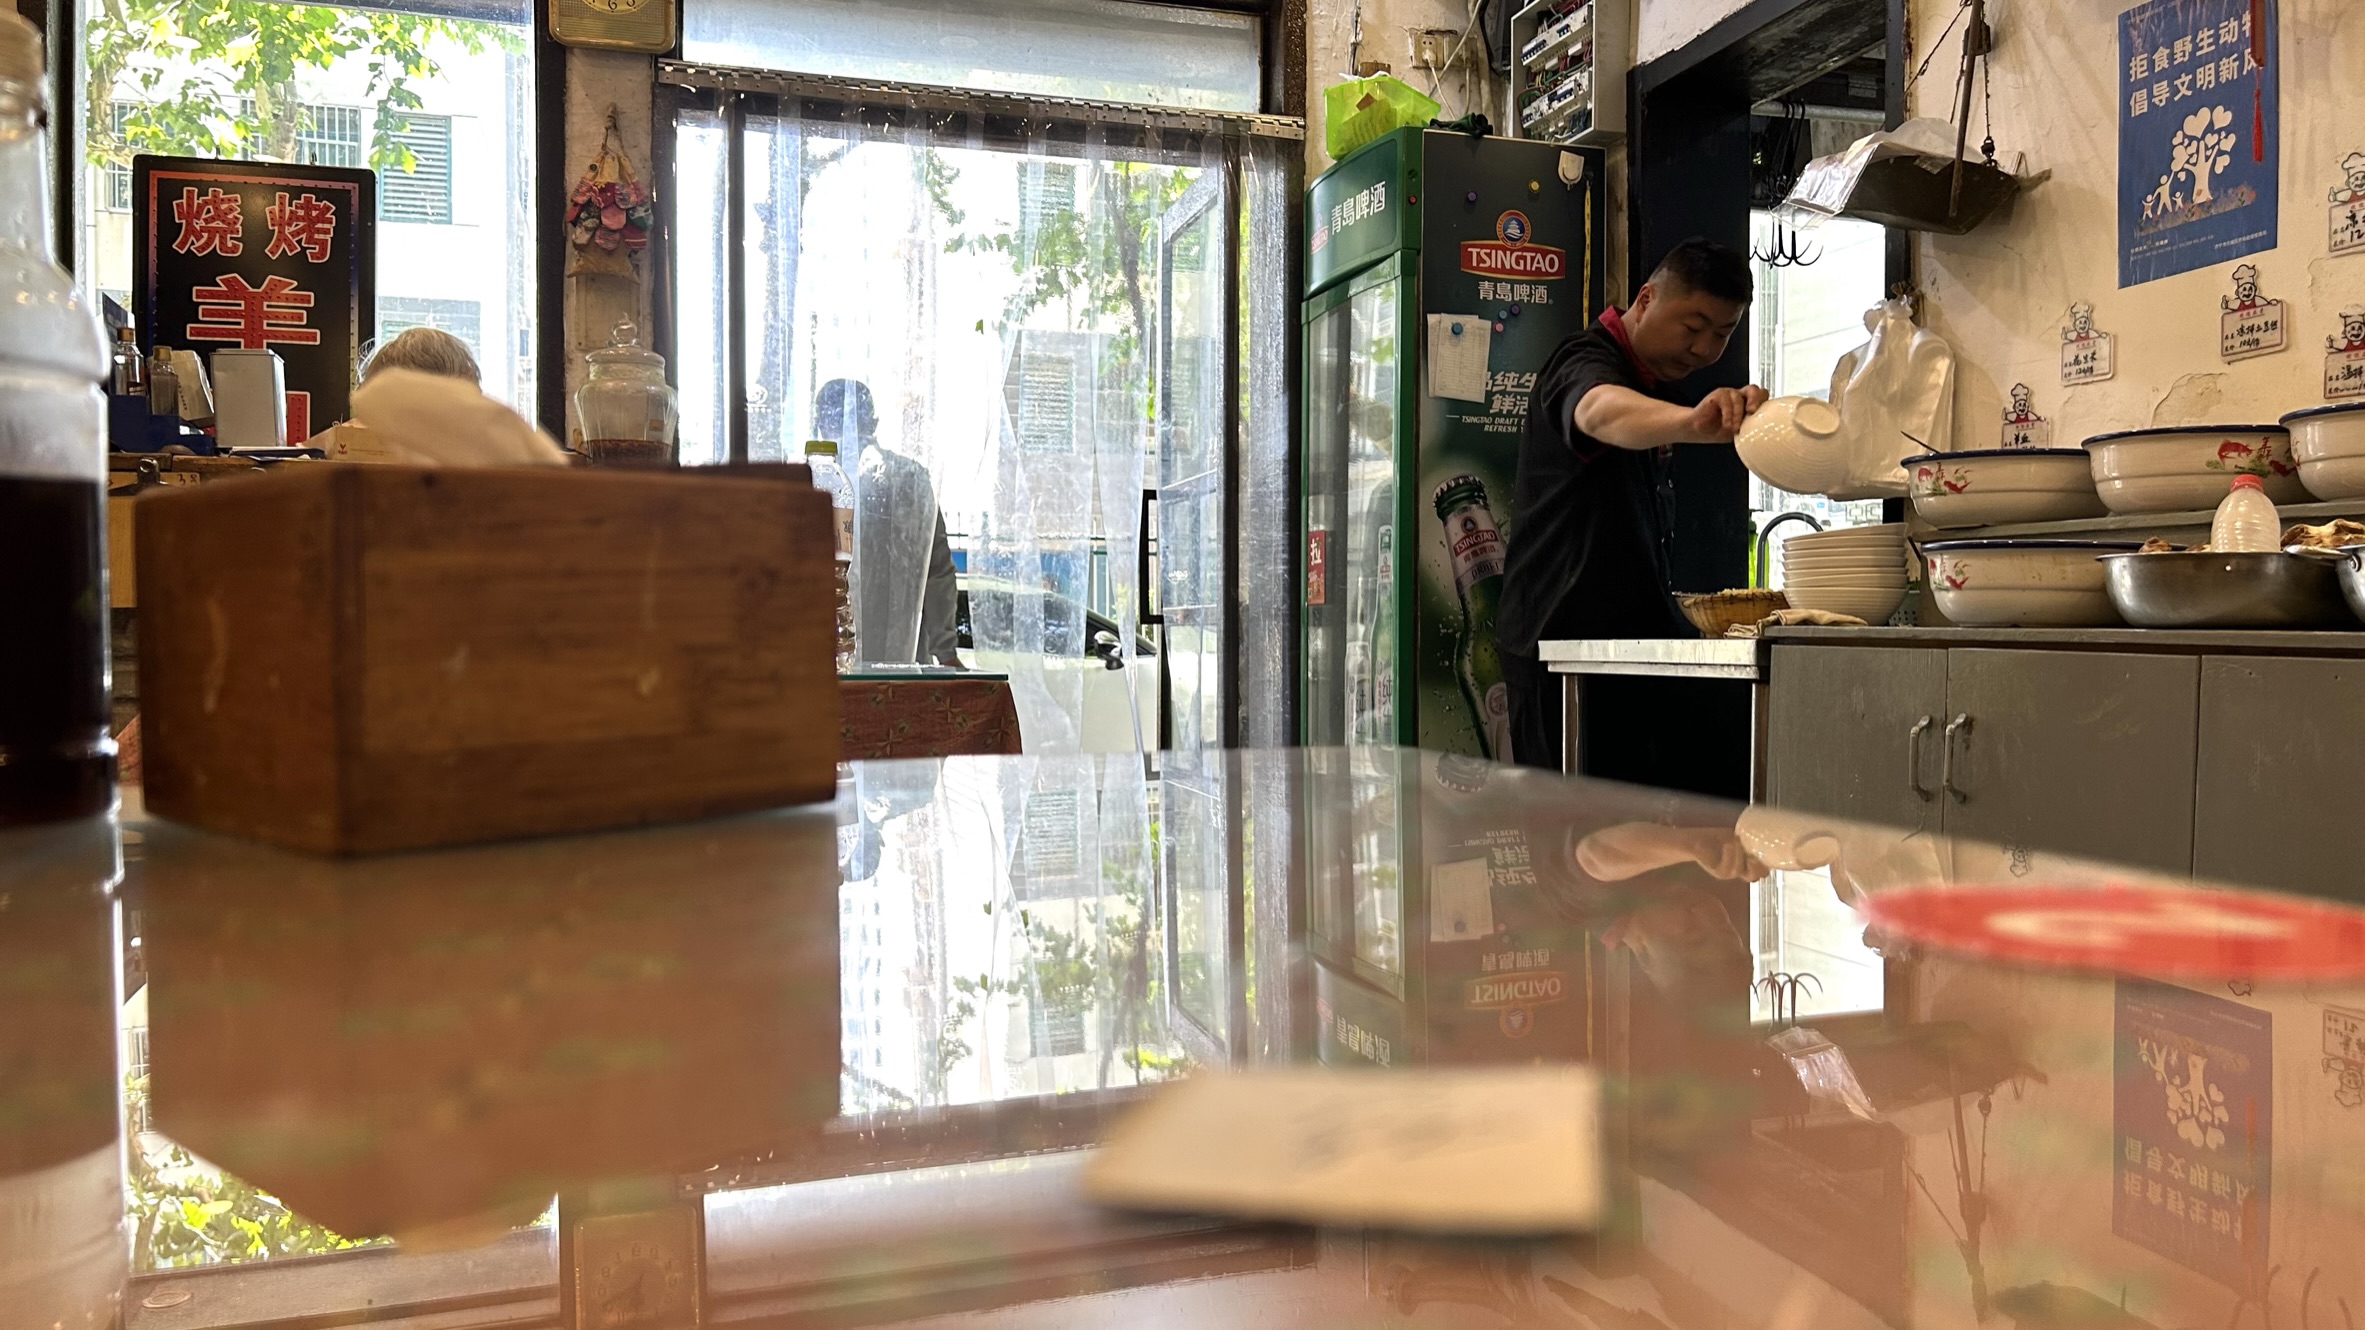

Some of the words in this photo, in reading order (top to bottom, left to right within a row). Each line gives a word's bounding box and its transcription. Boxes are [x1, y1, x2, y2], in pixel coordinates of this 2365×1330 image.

[2129, 47, 2257, 118] 倡导文明新风
[172, 186, 336, 263] 烧烤
[1467, 247, 1560, 274] TSINGTAO
[1478, 280, 1548, 304] 青島啤酒
[1484, 424, 1518, 433] REFRESH
[1494, 416, 1518, 426] DRAFT
